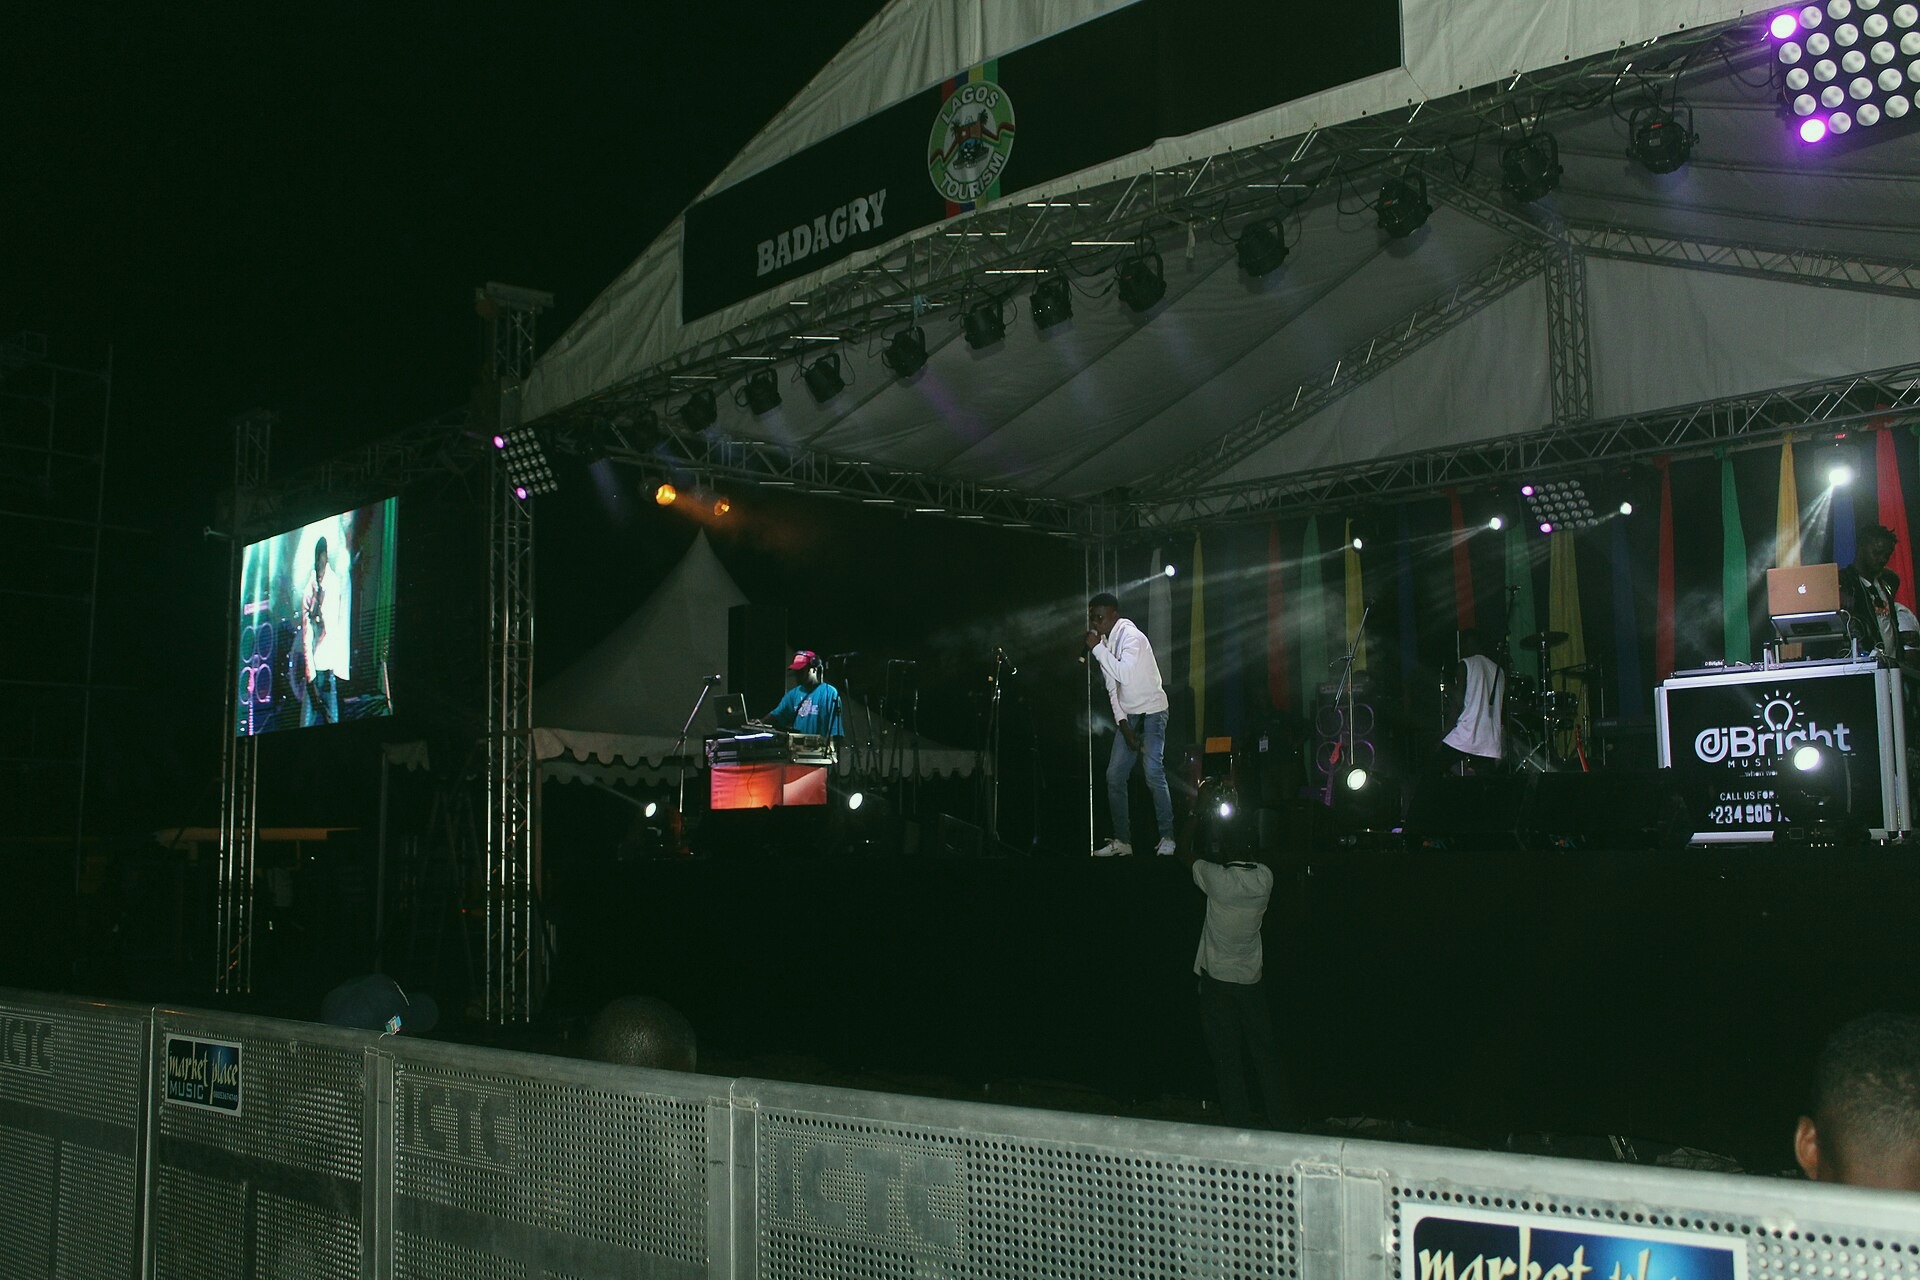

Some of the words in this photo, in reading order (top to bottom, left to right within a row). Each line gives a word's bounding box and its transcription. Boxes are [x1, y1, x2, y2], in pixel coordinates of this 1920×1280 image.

[941, 86, 999, 124] LAGOS
[940, 152, 1005, 200] TOURISM
[756, 188, 887, 278] BADAGRY
[1727, 757, 1783, 769] MUSI
[1708, 804, 1743, 825] +234
[1719, 791, 1742, 801] CALL
[1743, 790, 1756, 800] US
[1757, 789, 1775, 800] FOR
[168, 1041, 209, 1088] market
[209, 1049, 239, 1105] place
[169, 1080, 204, 1100] MUSIC
[403, 1079, 512, 1170] ICTC
[775, 1134, 958, 1254] ICTC
